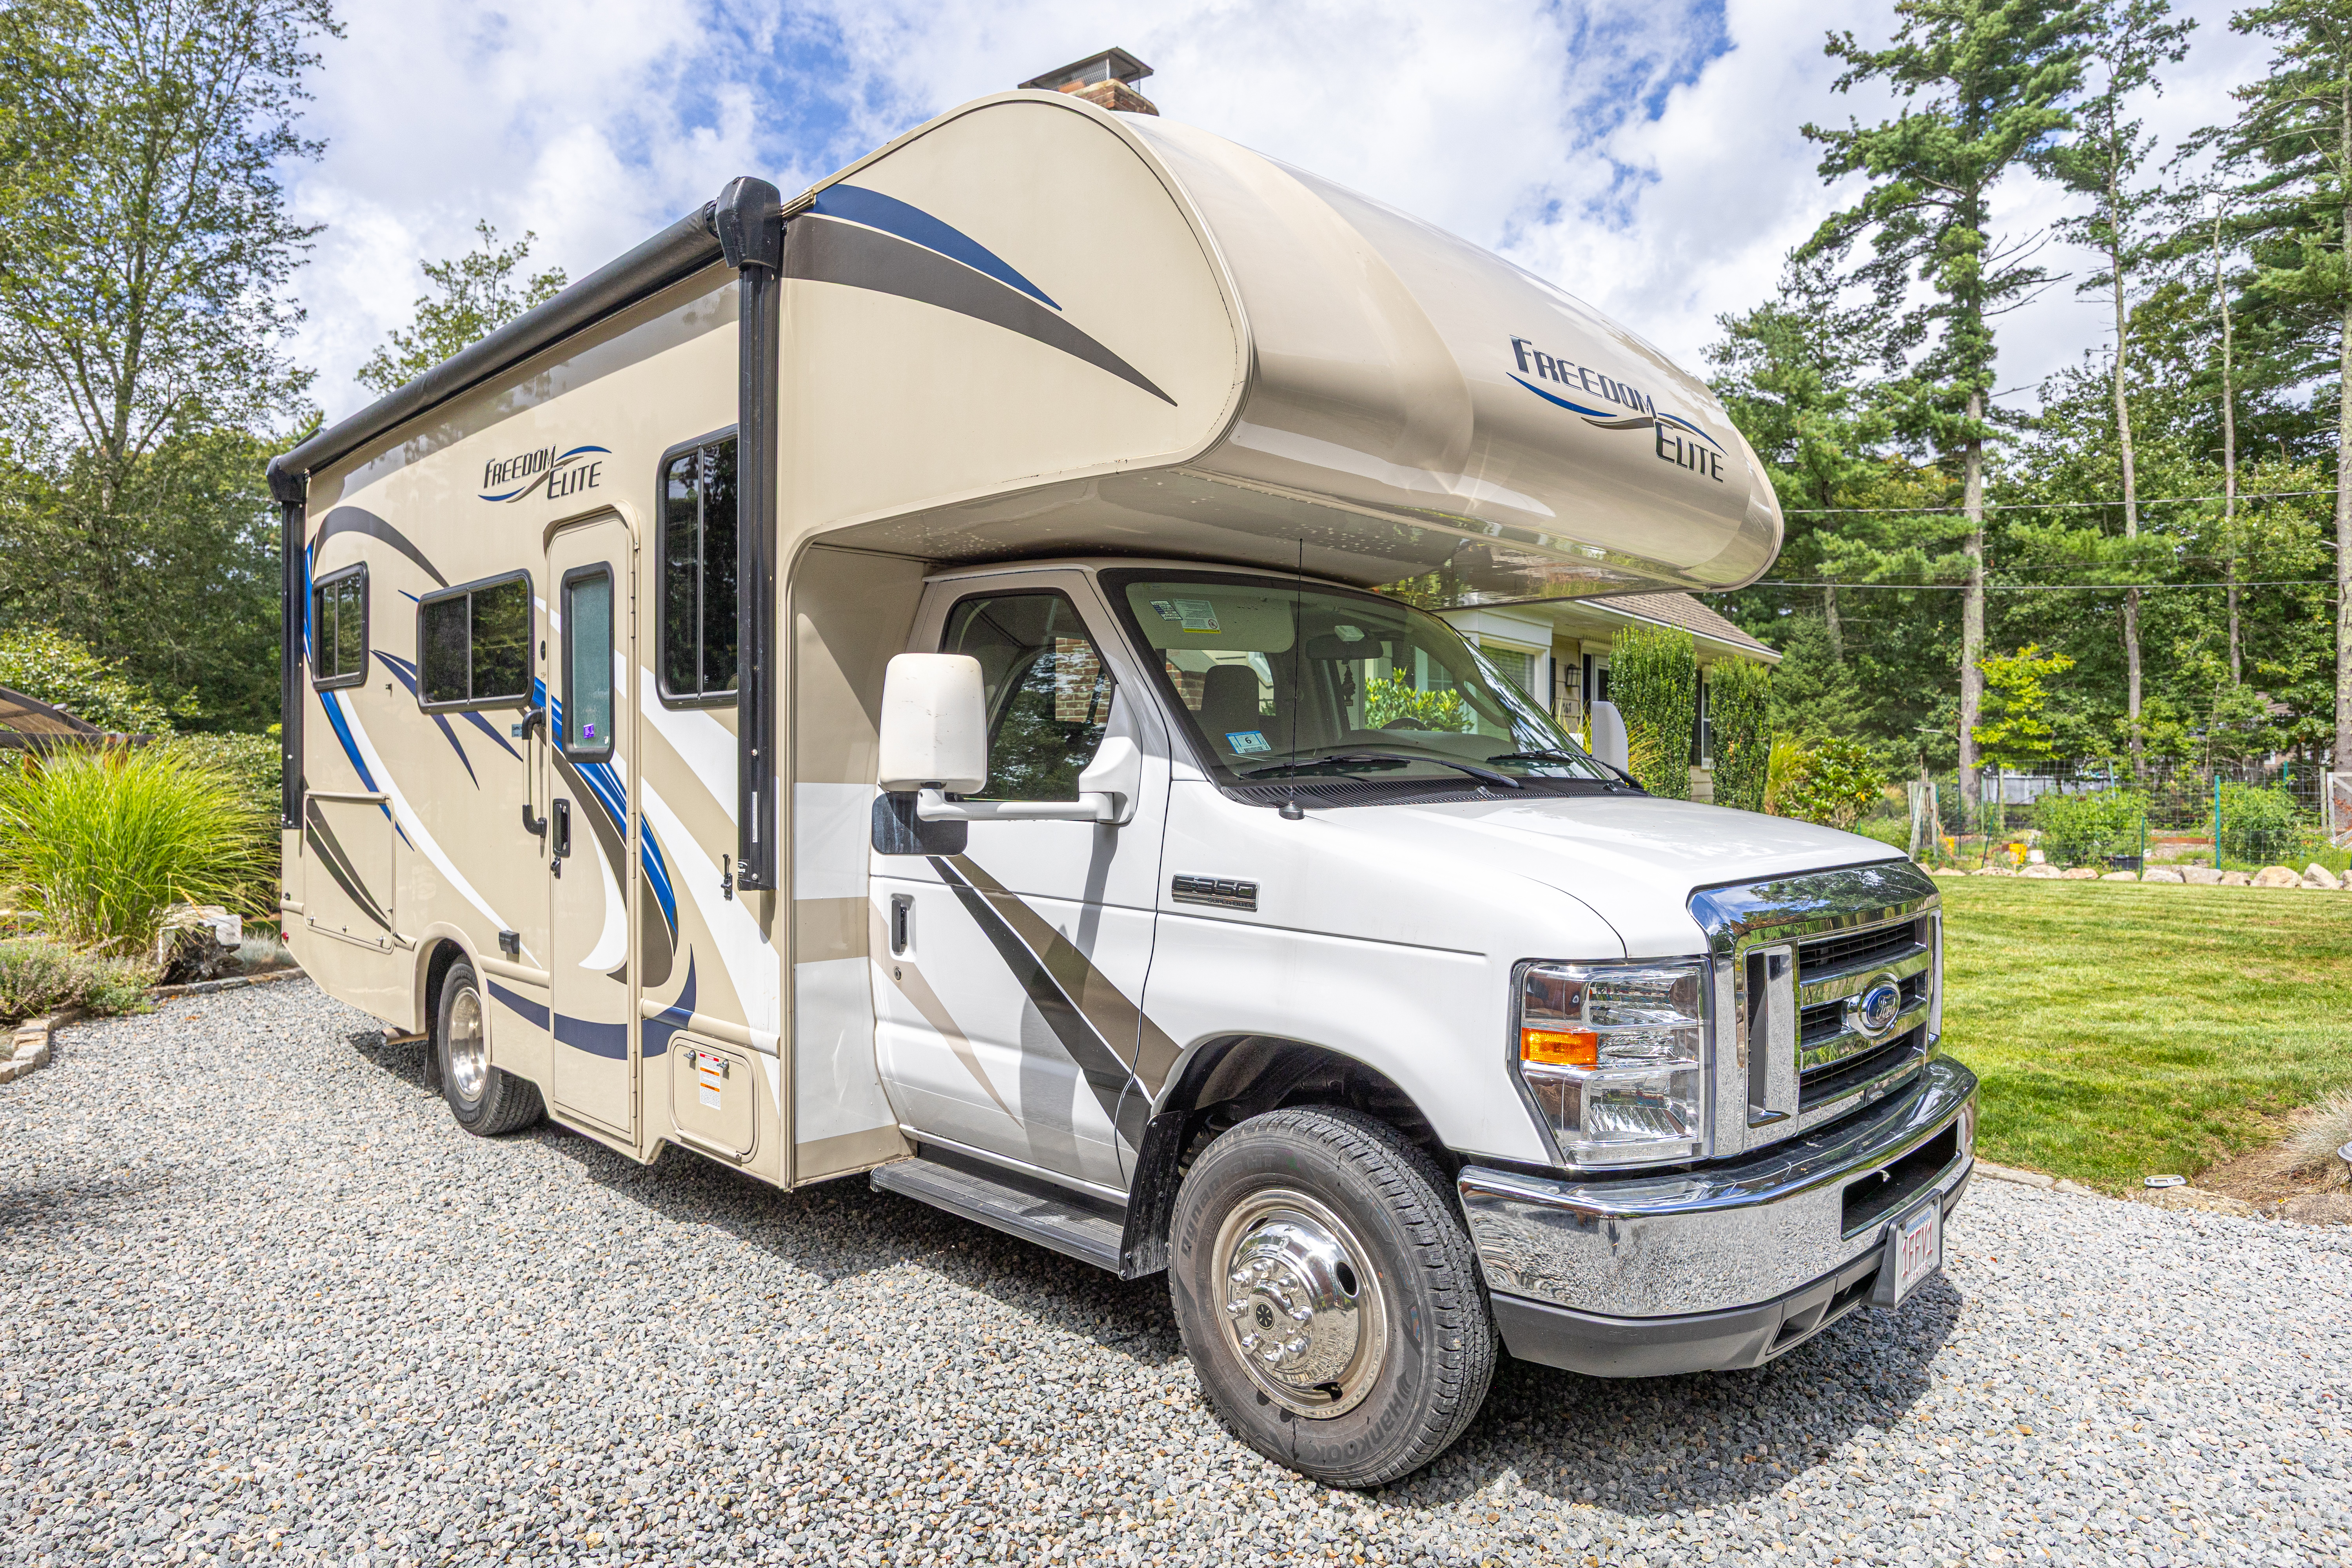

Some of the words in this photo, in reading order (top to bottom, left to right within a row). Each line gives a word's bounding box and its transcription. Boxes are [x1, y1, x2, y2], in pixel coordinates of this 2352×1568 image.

[1510, 335, 1657, 419] FREEDOM
[484, 444, 556, 489] FREEDOM
[1655, 420, 1723, 483] ELITE
[547, 461, 602, 500] ELITE
[1876, 993, 1896, 1020] Ford
[1906, 1210, 1931, 1235] Massachusetts
[1902, 1220, 1933, 1279] 1FFV1
[1908, 1261, 1927, 1284] CAMPER
